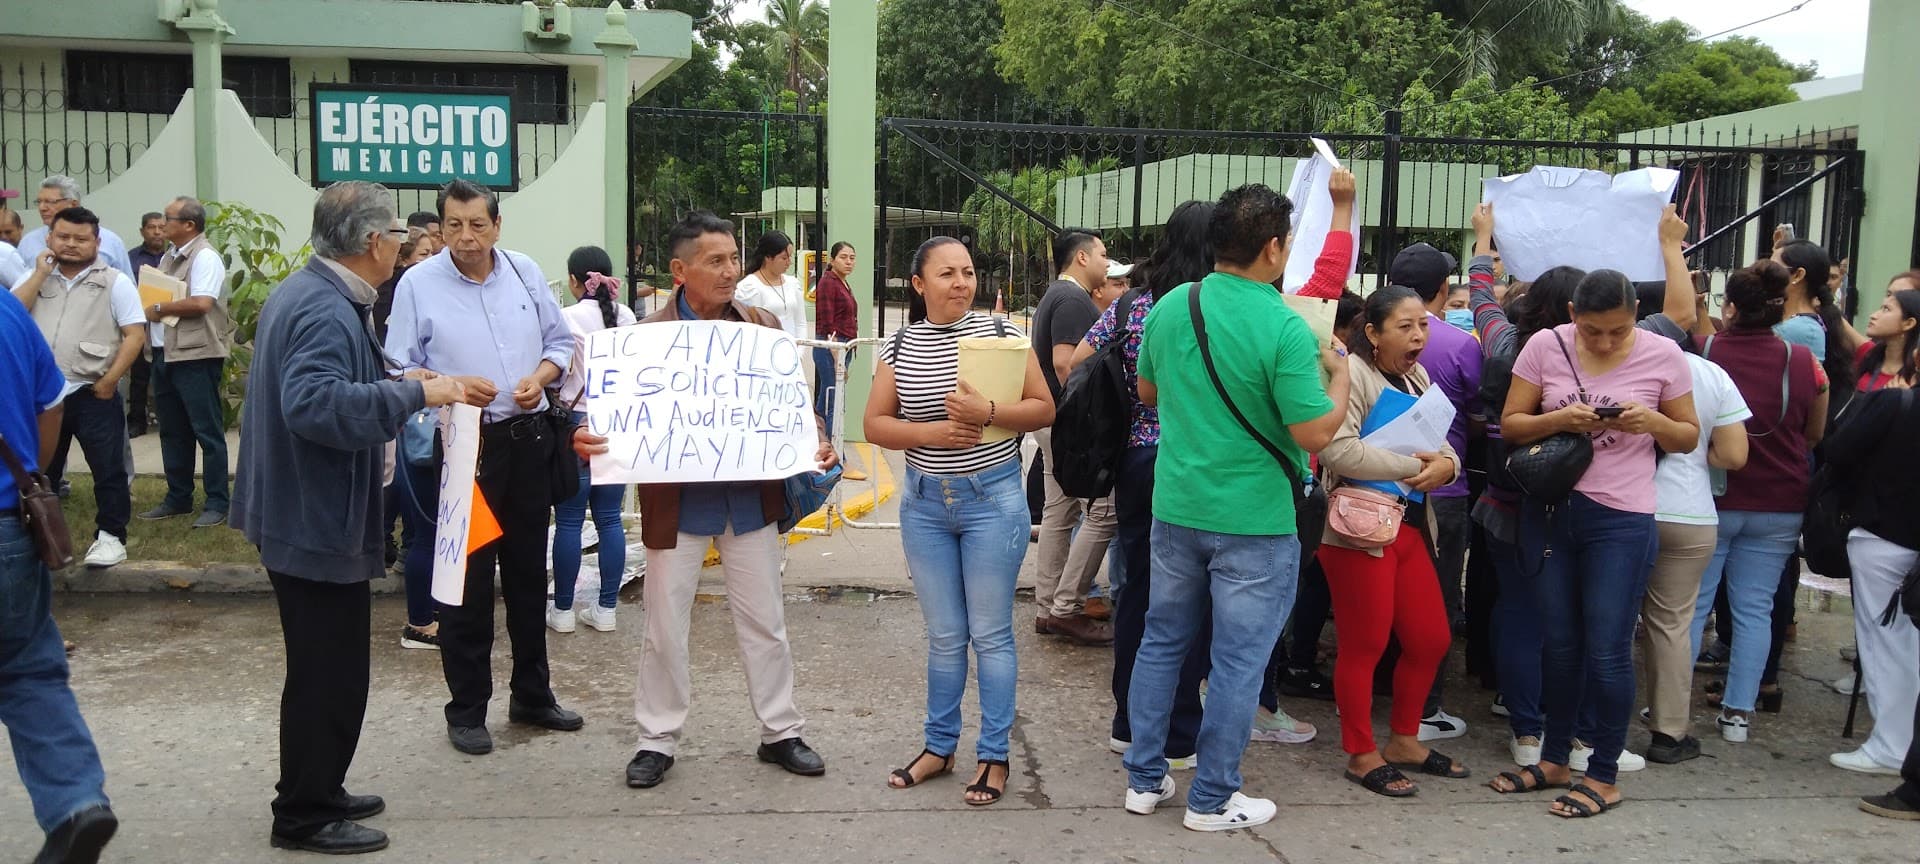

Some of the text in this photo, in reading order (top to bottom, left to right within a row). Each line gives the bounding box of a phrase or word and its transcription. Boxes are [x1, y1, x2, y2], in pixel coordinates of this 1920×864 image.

[320, 96, 507, 148] EJÉRCITO
[332, 148, 499, 175] MEXICANO
[664, 324, 799, 376] AMLO
[586, 367, 621, 399] LE
[590, 401, 653, 436] UNA
